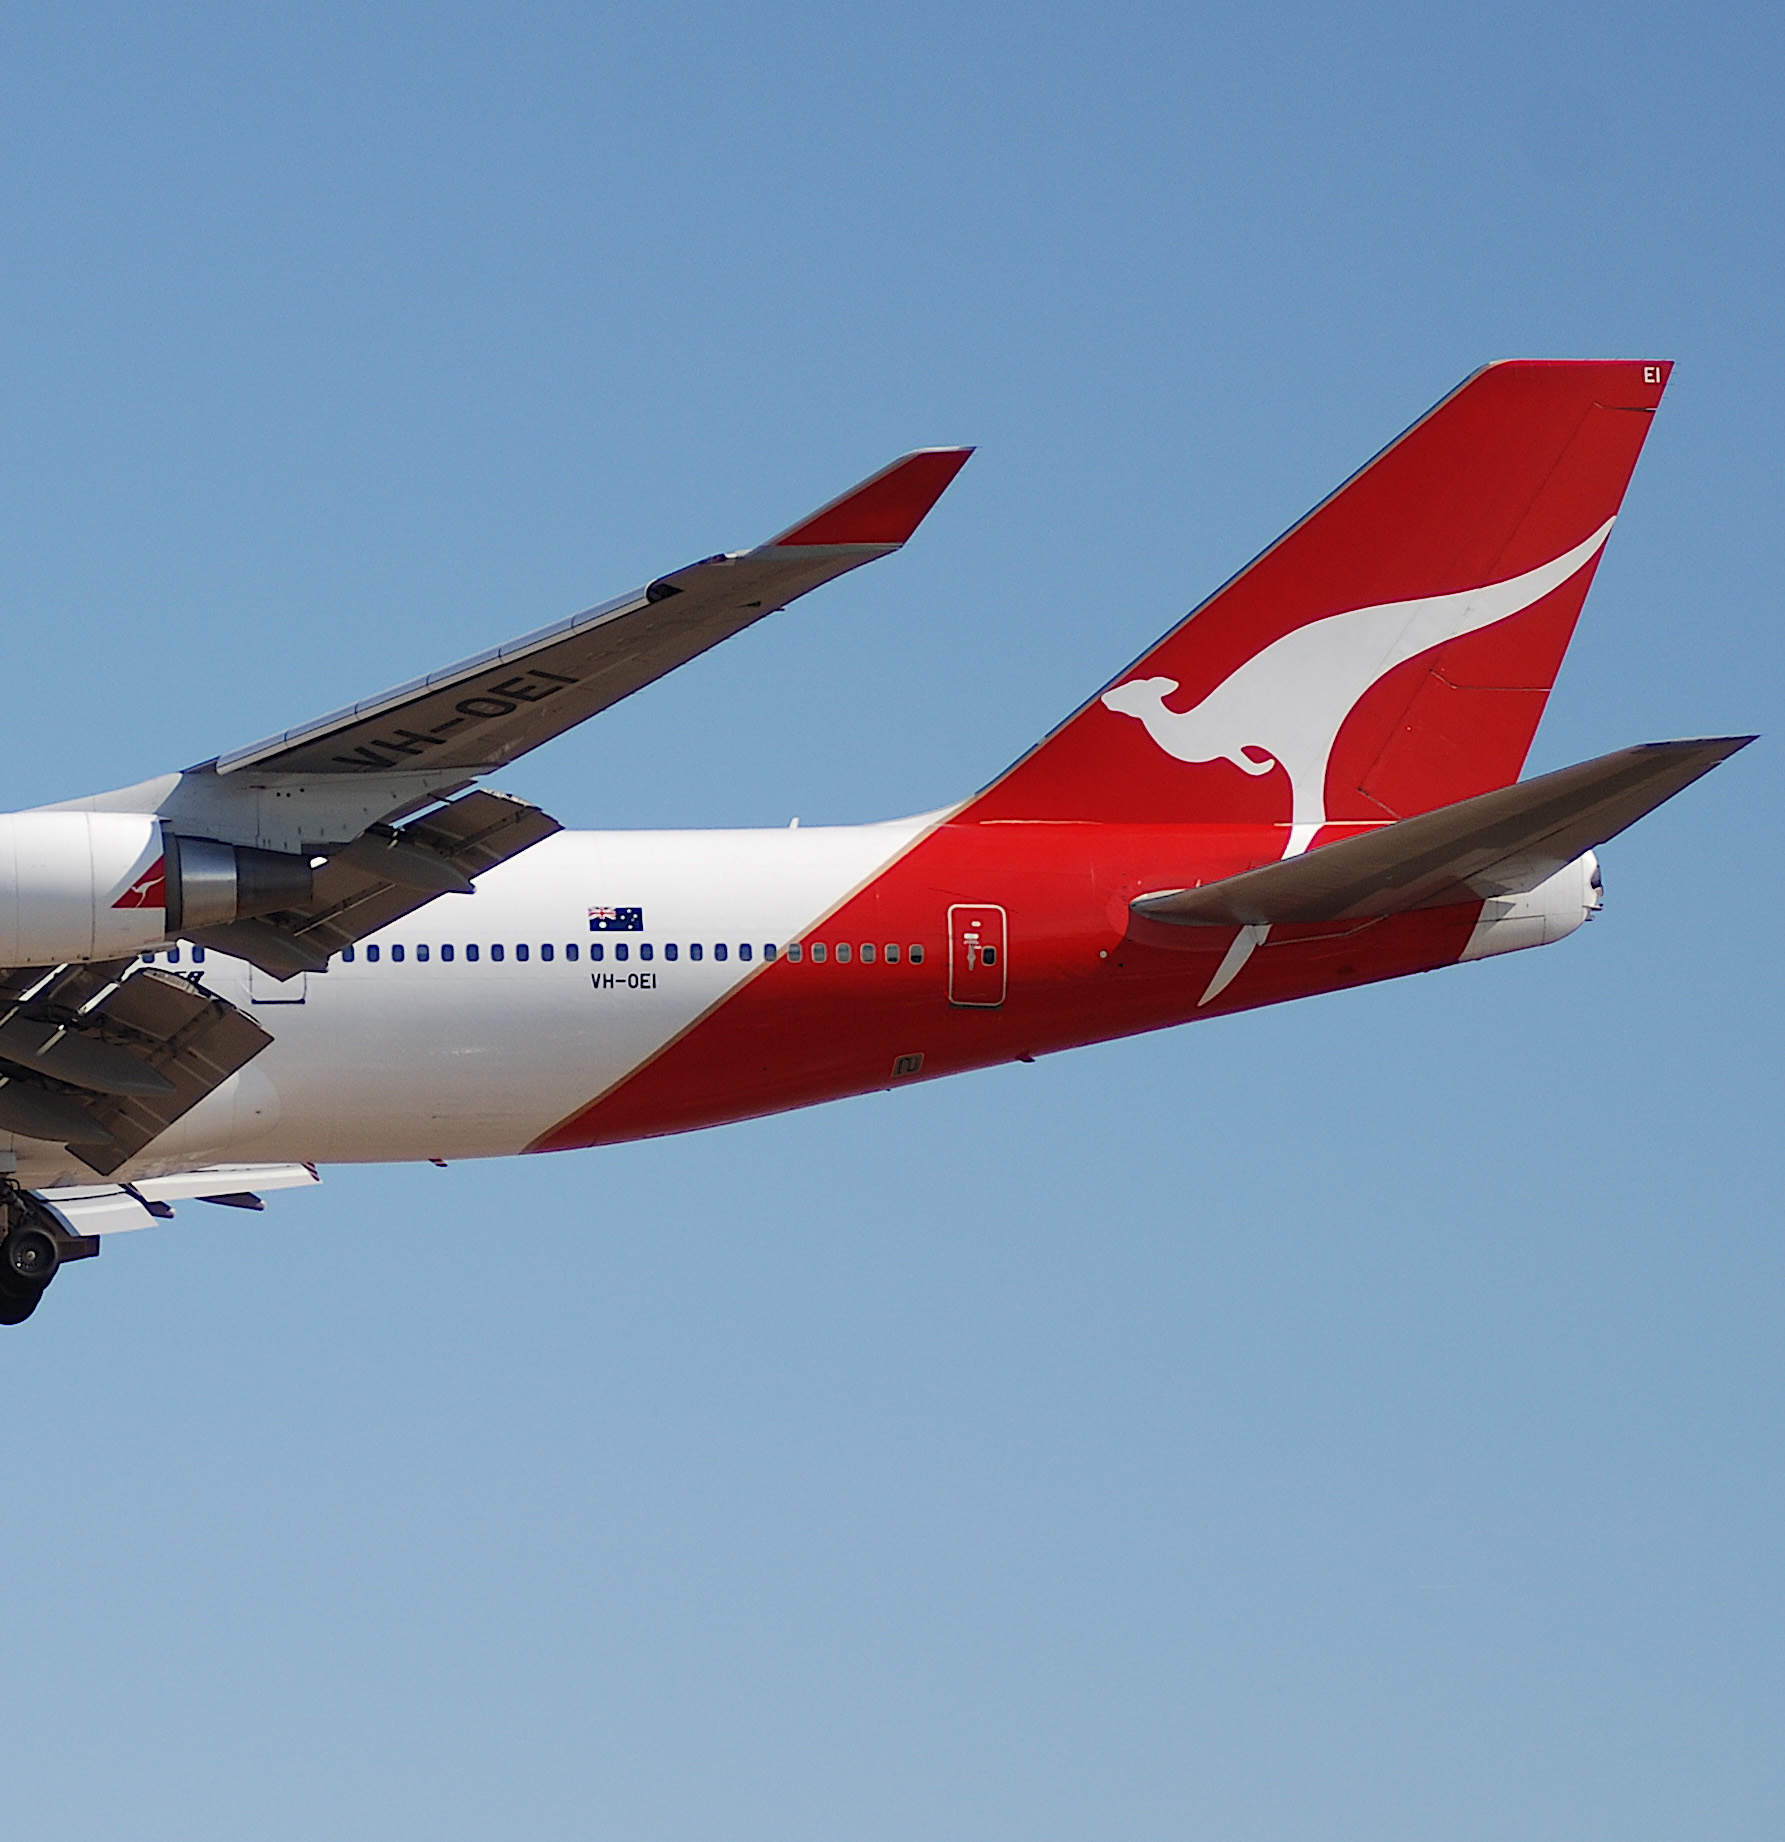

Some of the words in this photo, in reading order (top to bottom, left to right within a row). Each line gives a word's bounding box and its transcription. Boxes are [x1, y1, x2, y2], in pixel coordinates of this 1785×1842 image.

[1643, 366, 1661, 383] EI
[331, 668, 580, 768] VH-OEI
[591, 973, 657, 989] VH-OEI
